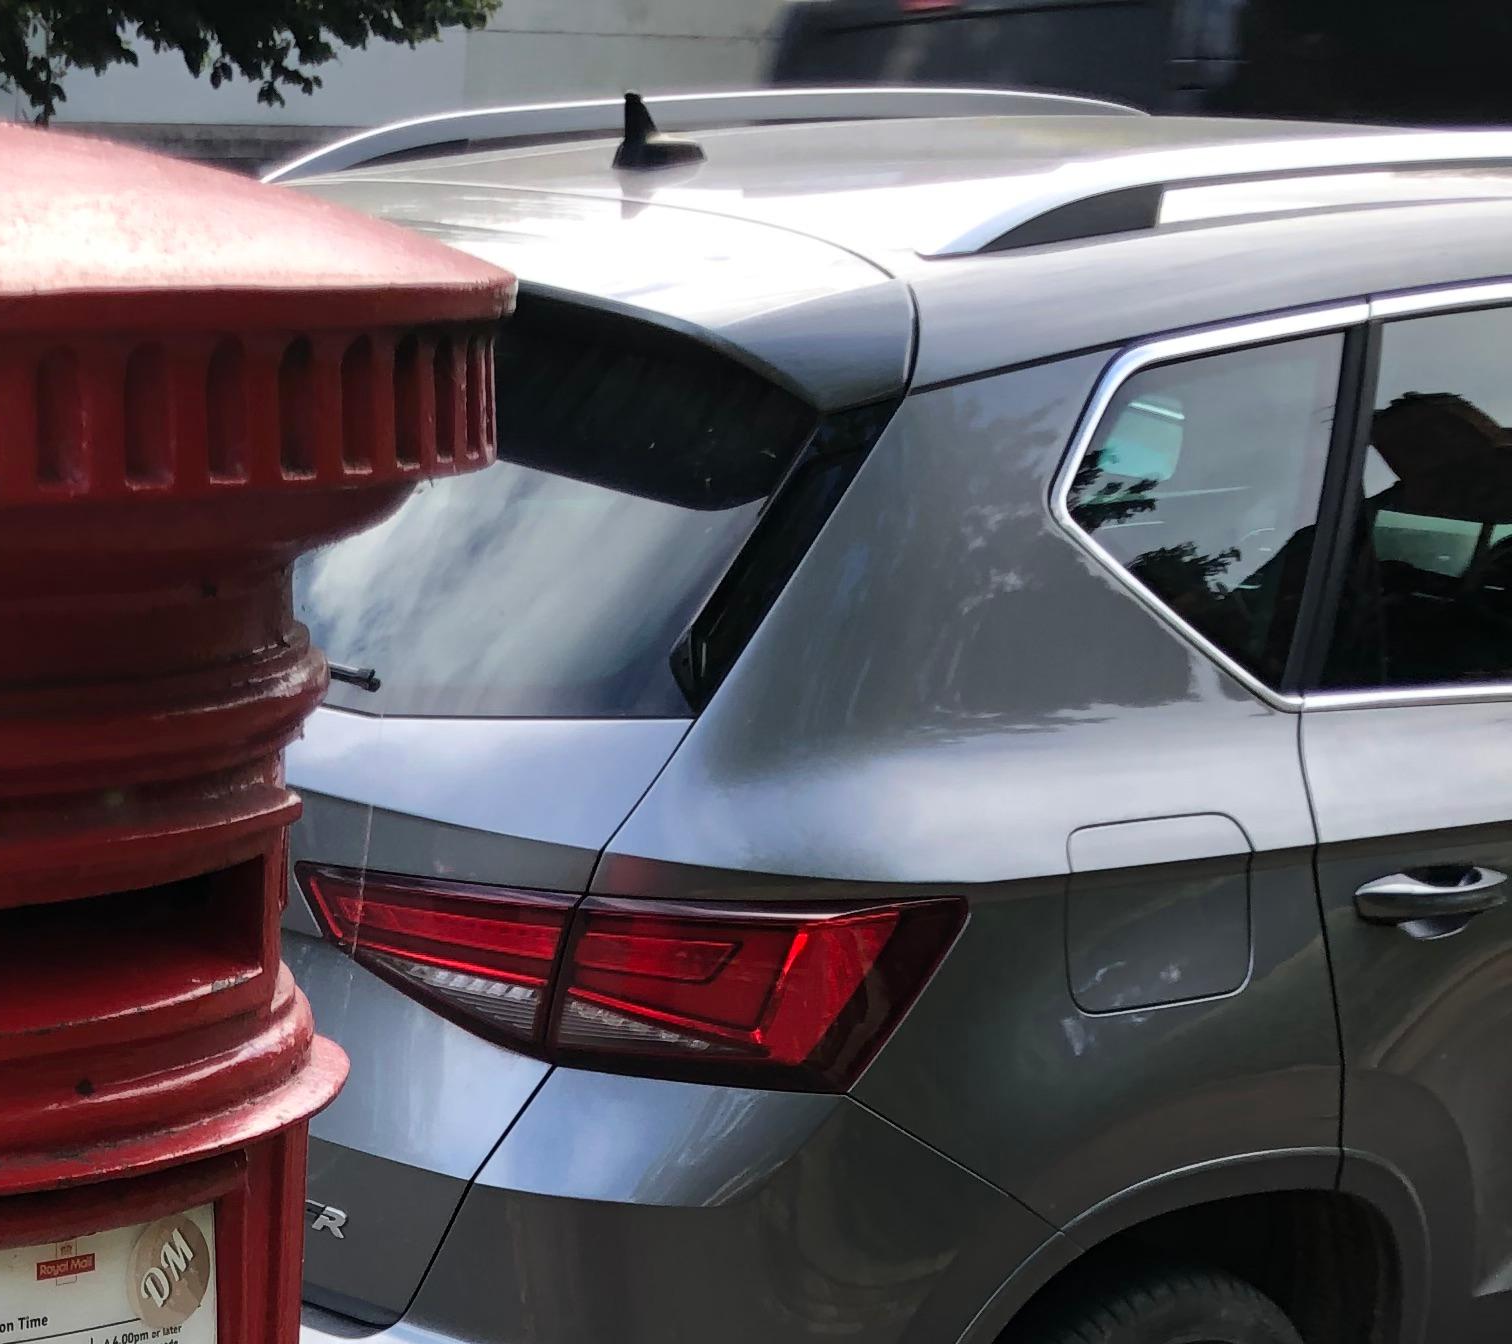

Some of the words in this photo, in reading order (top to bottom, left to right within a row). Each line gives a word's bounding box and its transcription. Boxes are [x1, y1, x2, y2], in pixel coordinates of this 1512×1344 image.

[39, 1260, 69, 1276] Royal
[70, 1256, 93, 1270] Mail
[140, 1228, 194, 1308] DM
[18, 1315, 48, 1331] Time
[113, 1332, 148, 1344] 4.00pm
[152, 1330, 160, 1338] or
[163, 1325, 182, 1336] later
